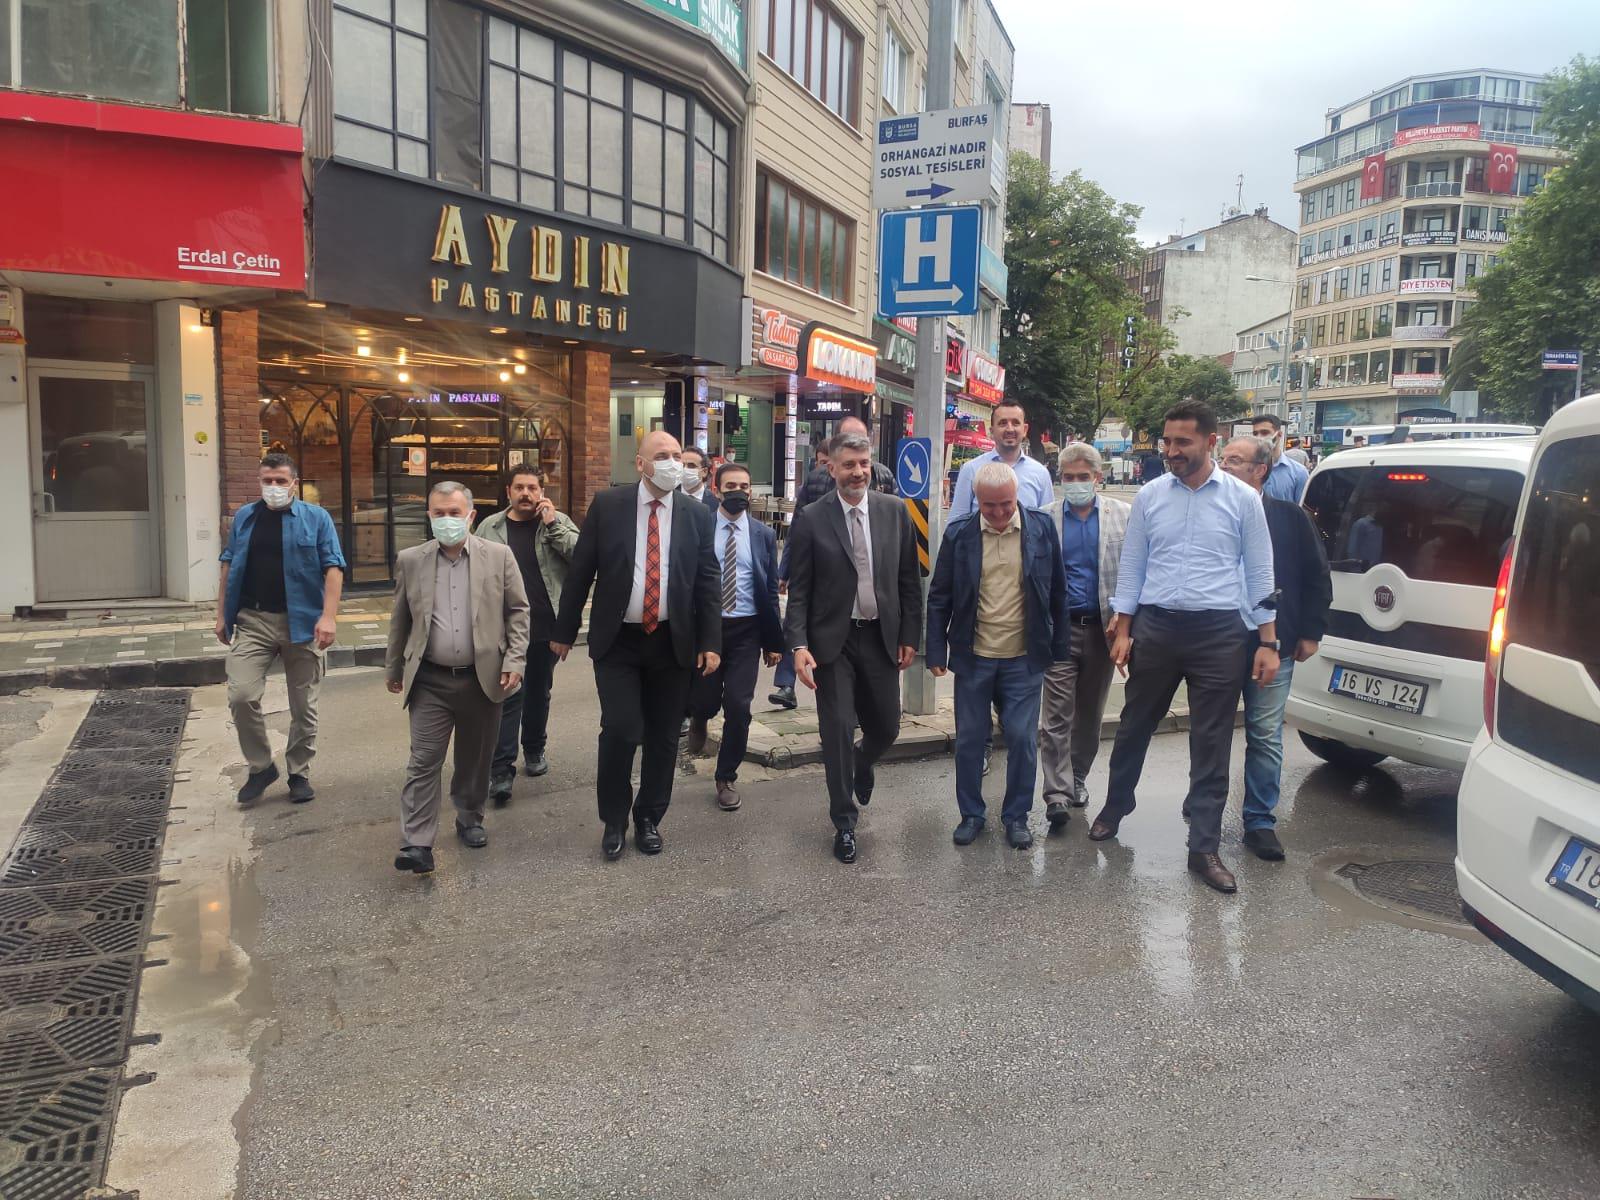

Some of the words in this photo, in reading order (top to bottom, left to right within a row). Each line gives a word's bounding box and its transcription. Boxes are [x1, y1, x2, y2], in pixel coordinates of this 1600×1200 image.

[948, 114, 988, 128] BURFAŞ
[881, 142, 946, 162] ORHANGAZİ
[949, 141, 986, 155] NADIR
[880, 165, 922, 179] SOSYAL
[926, 155, 985, 174] TESİSLERİ
[177, 247, 227, 264] Erdal
[233, 252, 280, 269] Çetin
[432, 204, 630, 296] AYDIN
[903, 214, 953, 284] H
[431, 277, 627, 332] PASTANESİ
[1342, 672, 1357, 690] 16
[1365, 677, 1382, 696] VS
[1391, 684, 1418, 705] 124
